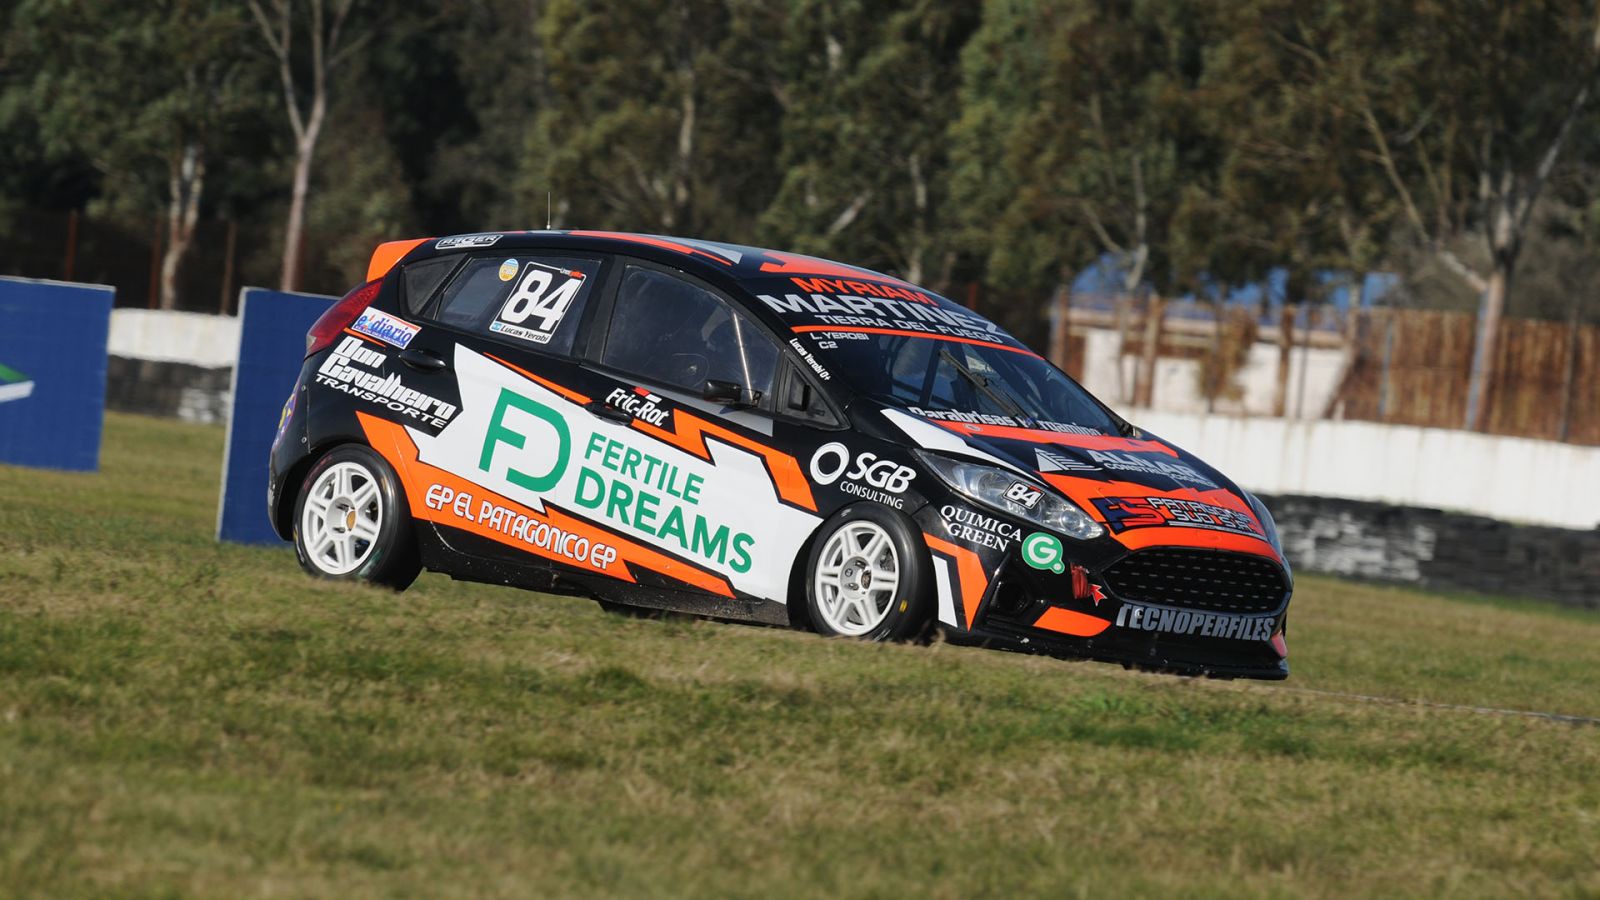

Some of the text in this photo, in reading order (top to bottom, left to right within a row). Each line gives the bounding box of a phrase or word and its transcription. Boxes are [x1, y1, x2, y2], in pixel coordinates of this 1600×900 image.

[501, 270, 582, 331] 84
[791, 277, 939, 307] MYRIAM
[371, 317, 412, 345] diario
[756, 294, 1008, 336] MARTINEZ
[814, 314, 1003, 344] TIERRA DEL FUEGO
[501, 325, 549, 343] Lucas Yerobi
[809, 332, 870, 341] L. YEROBI
[818, 341, 838, 349] C2
[334, 336, 387, 369] Don
[789, 338, 808, 356] Lucas
[804, 353, 825, 374] Yerobi
[315, 374, 448, 428] TRANSPORTE
[319, 353, 457, 420] Cavalheiro
[605, 387, 670, 427] Fric-Rot
[585, 432, 705, 505] FERTILE
[846, 452, 916, 494] SGB
[840, 480, 904, 510] CONSULTING
[1006, 483, 1042, 507] 84
[425, 483, 617, 569] EP EL PATAGONICO EP
[574, 466, 755, 574] DREAMS
[940, 504, 1022, 543] QUIMICA
[1170, 509, 1216, 524] SUD
[949, 521, 1011, 553] GREEN
[1116, 603, 1275, 642] TECNOPERFILES
